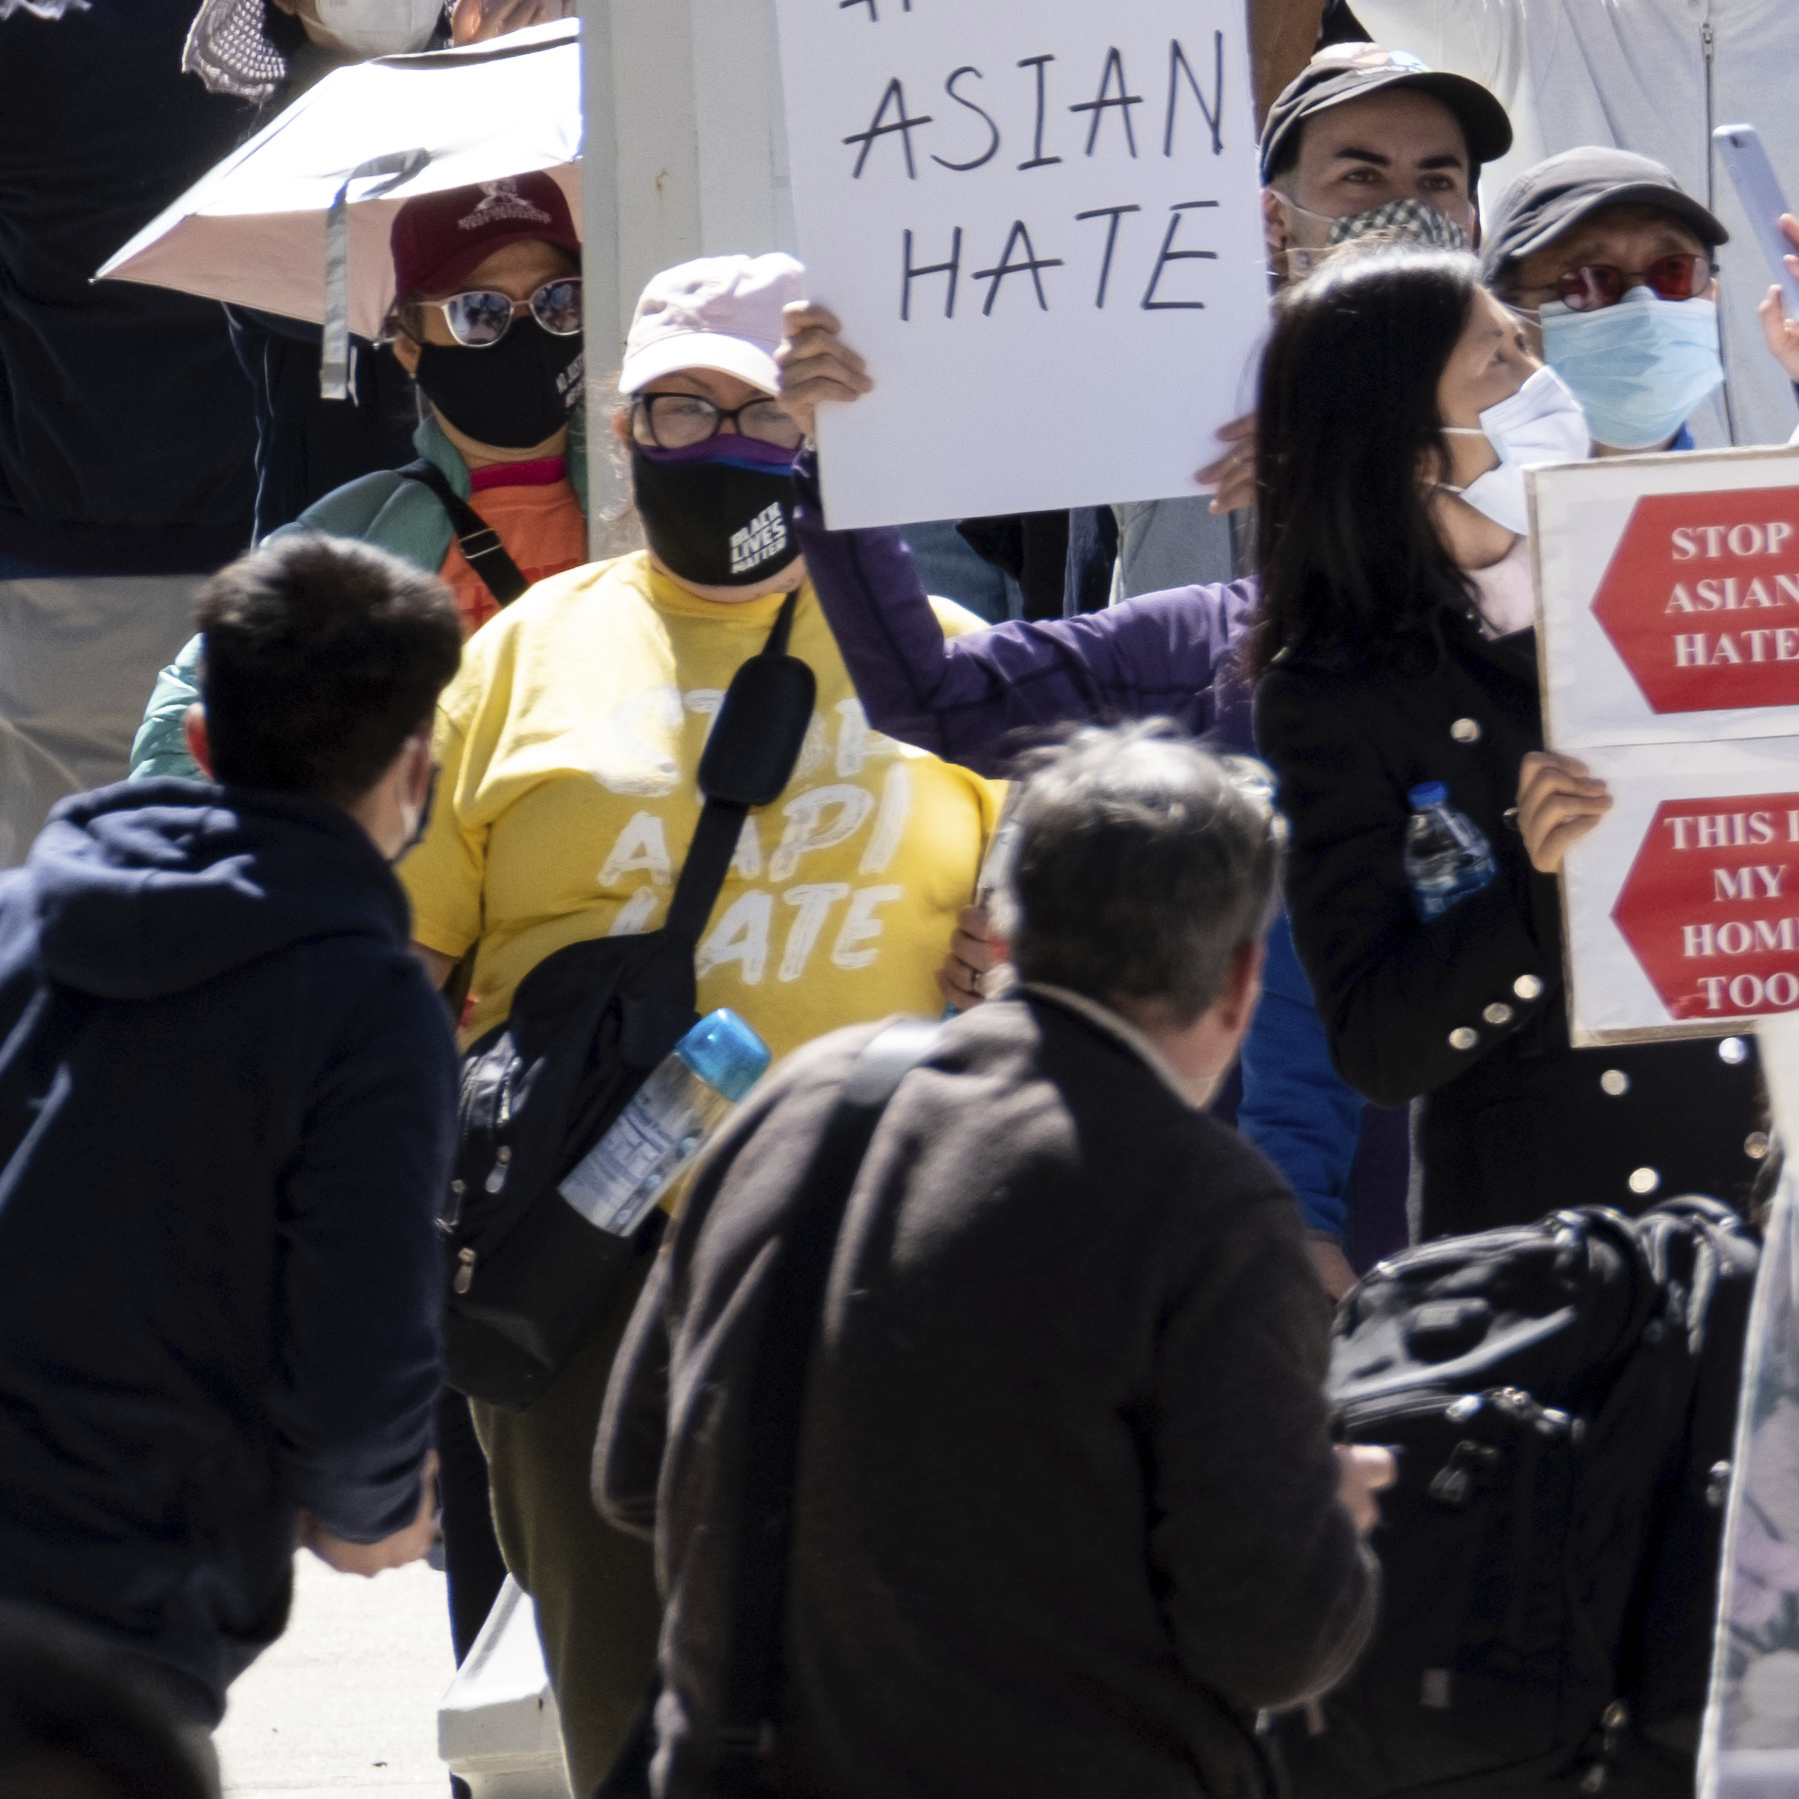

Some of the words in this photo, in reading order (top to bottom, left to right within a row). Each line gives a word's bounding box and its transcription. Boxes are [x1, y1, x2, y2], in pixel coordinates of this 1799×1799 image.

[843, 29, 1224, 181] ASIAN
[899, 200, 1220, 321] HATE
[729, 501, 782, 549] BLACK
[731, 519, 787, 564] LIVES
[1670, 521, 1794, 561] STOP
[1663, 811, 1773, 851] THIS
[1711, 864, 1788, 902] MY
